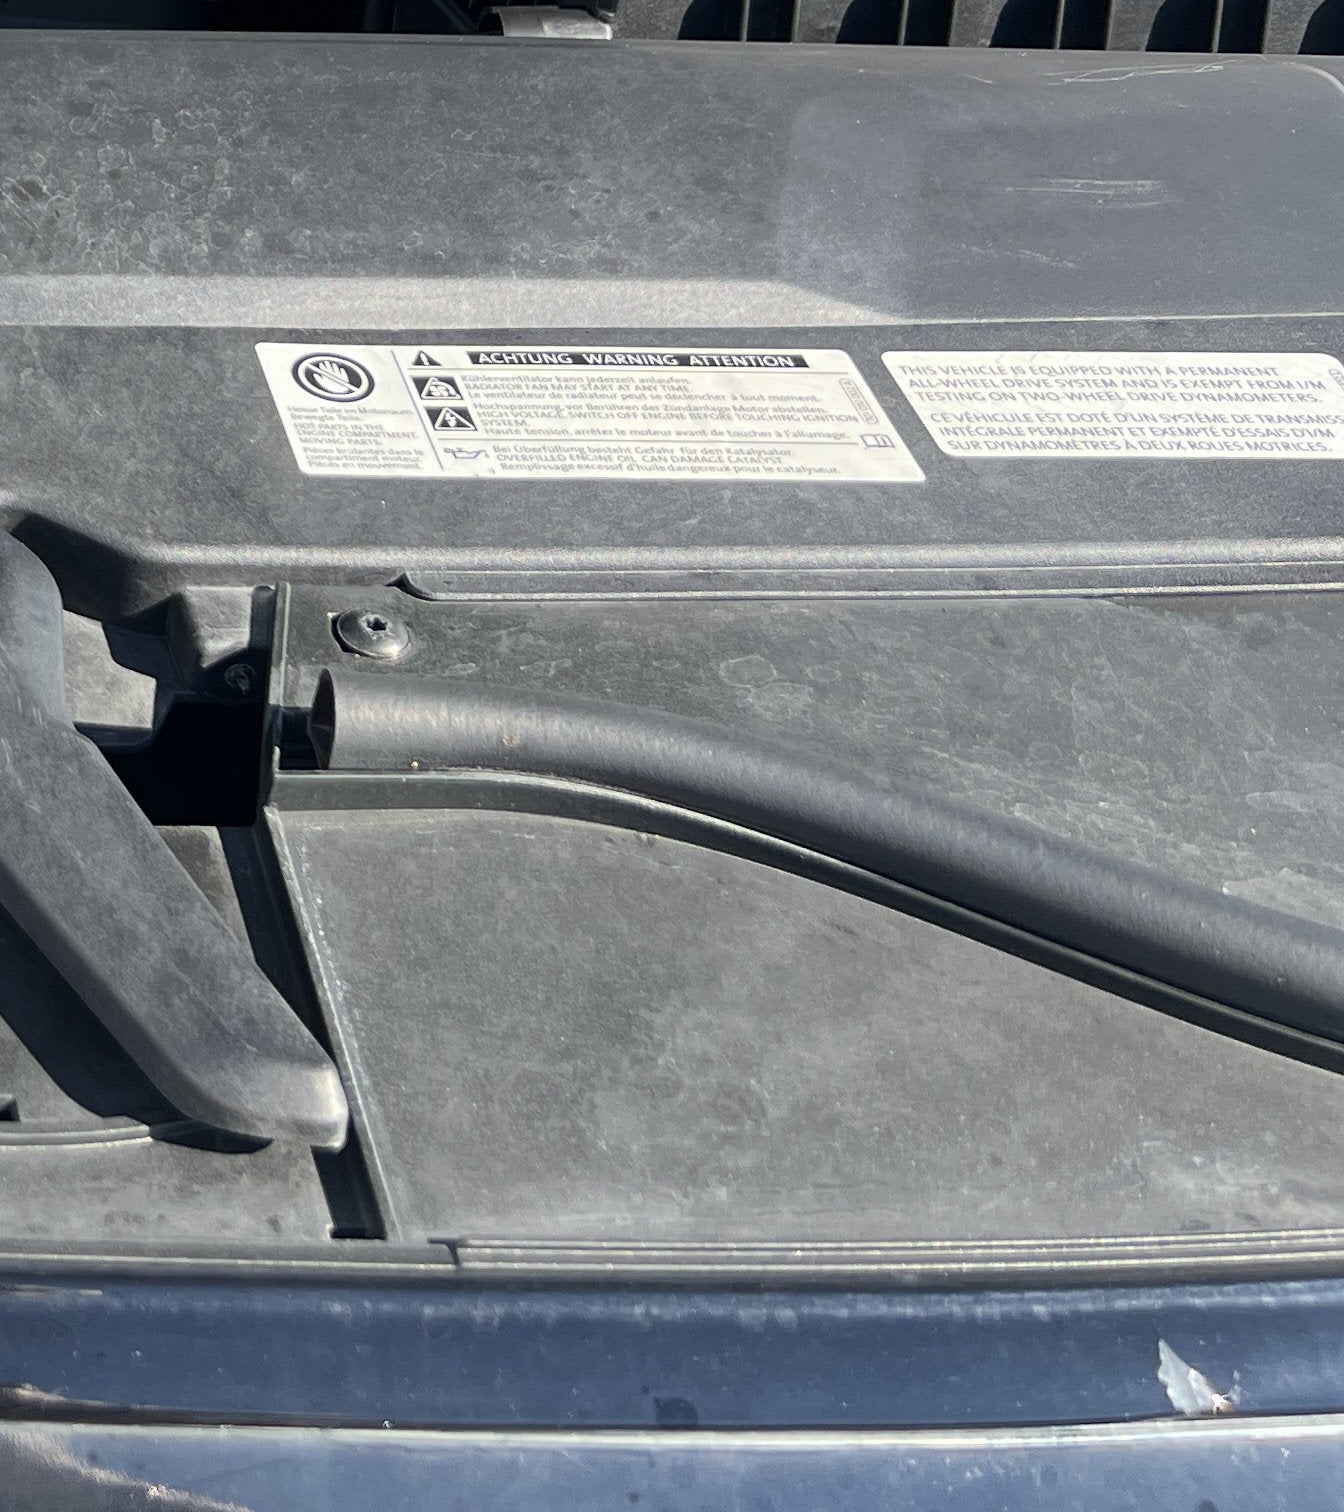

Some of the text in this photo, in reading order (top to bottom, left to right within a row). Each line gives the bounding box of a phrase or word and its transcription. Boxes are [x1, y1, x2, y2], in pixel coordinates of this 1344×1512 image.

[478, 353, 795, 367] ACHTUNG WARNING ATTENTION
[897, 364, 1280, 378] THIS VEHICLE IS EQUIPPED WITH A PERMANENT
[1000, 378, 1053, 389] DRIVE
[1054, 379, 1118, 389] SYSTEM
[1121, 379, 1159, 389] AND
[1161, 380, 1178, 389] IS
[1179, 380, 1244, 390] EXEMPT
[1247, 380, 1294, 390] FROM
[914, 391, 987, 402] TESTING
[988, 391, 1016, 402] ON
[1127, 392, 1179, 402] DRIVE
[929, 412, 950, 423] CE
[1034, 412, 1064, 423] EST
[1230, 413, 1252, 424] DE
[1028, 426, 1126, 437] PERMANENT
[1127, 427, 1148, 437] ET
[946, 440, 983, 451] SUR
[1137, 440, 1186, 451] DEUX
[1186, 440, 1245, 452] ROUES
